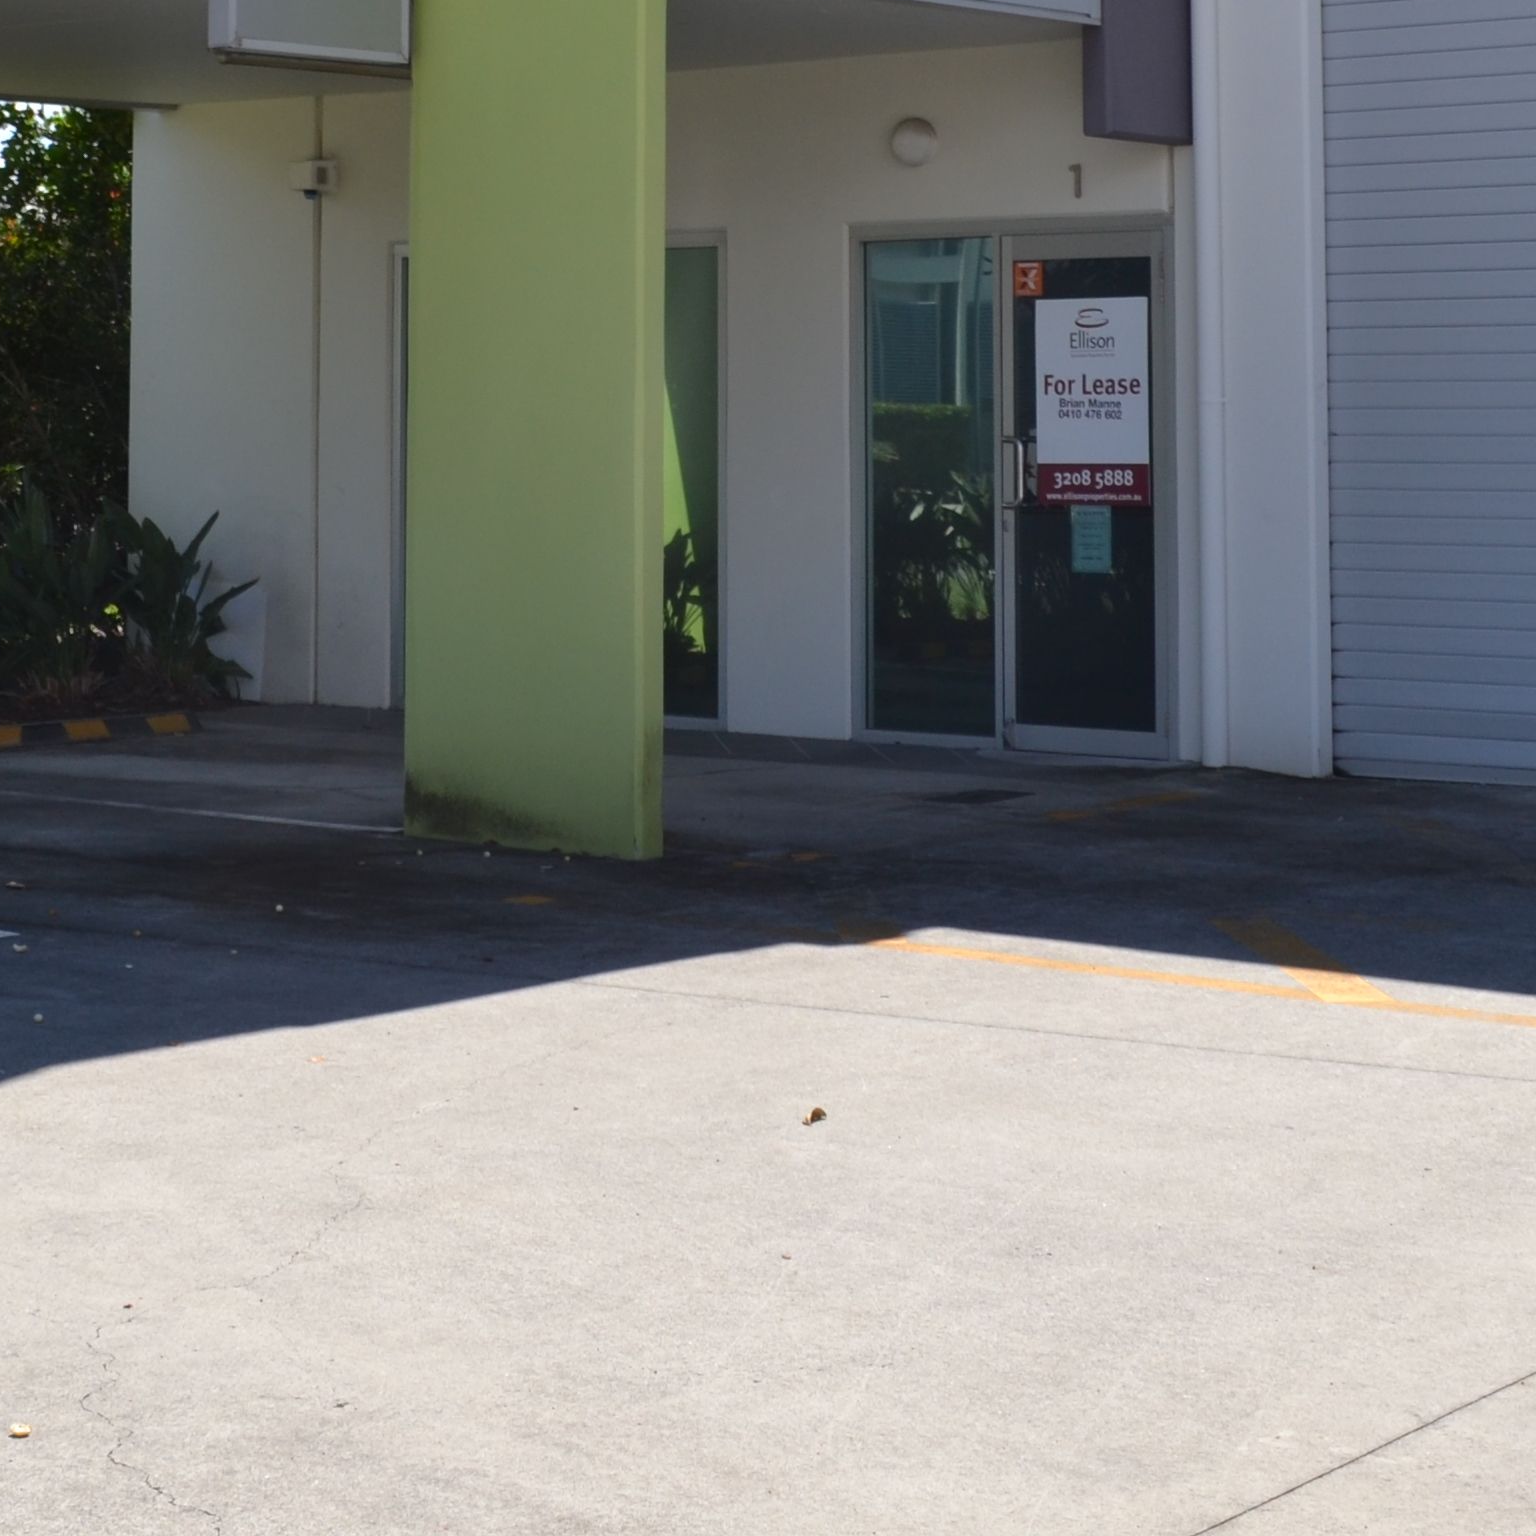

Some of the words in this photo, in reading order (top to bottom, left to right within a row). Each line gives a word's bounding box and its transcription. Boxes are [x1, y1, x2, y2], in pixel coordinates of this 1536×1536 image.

[1068, 163, 1082, 199] 1
[1069, 330, 1115, 349] Ellison
[1044, 374, 1075, 396] For
[1082, 373, 1141, 395] Lease
[1059, 398, 1085, 409] Brian
[1058, 409, 1082, 419] 0410
[1084, 409, 1102, 419] 476
[1104, 410, 1123, 420] 602
[1054, 469, 1091, 489] 3208
[1095, 469, 1134, 489] 5888
